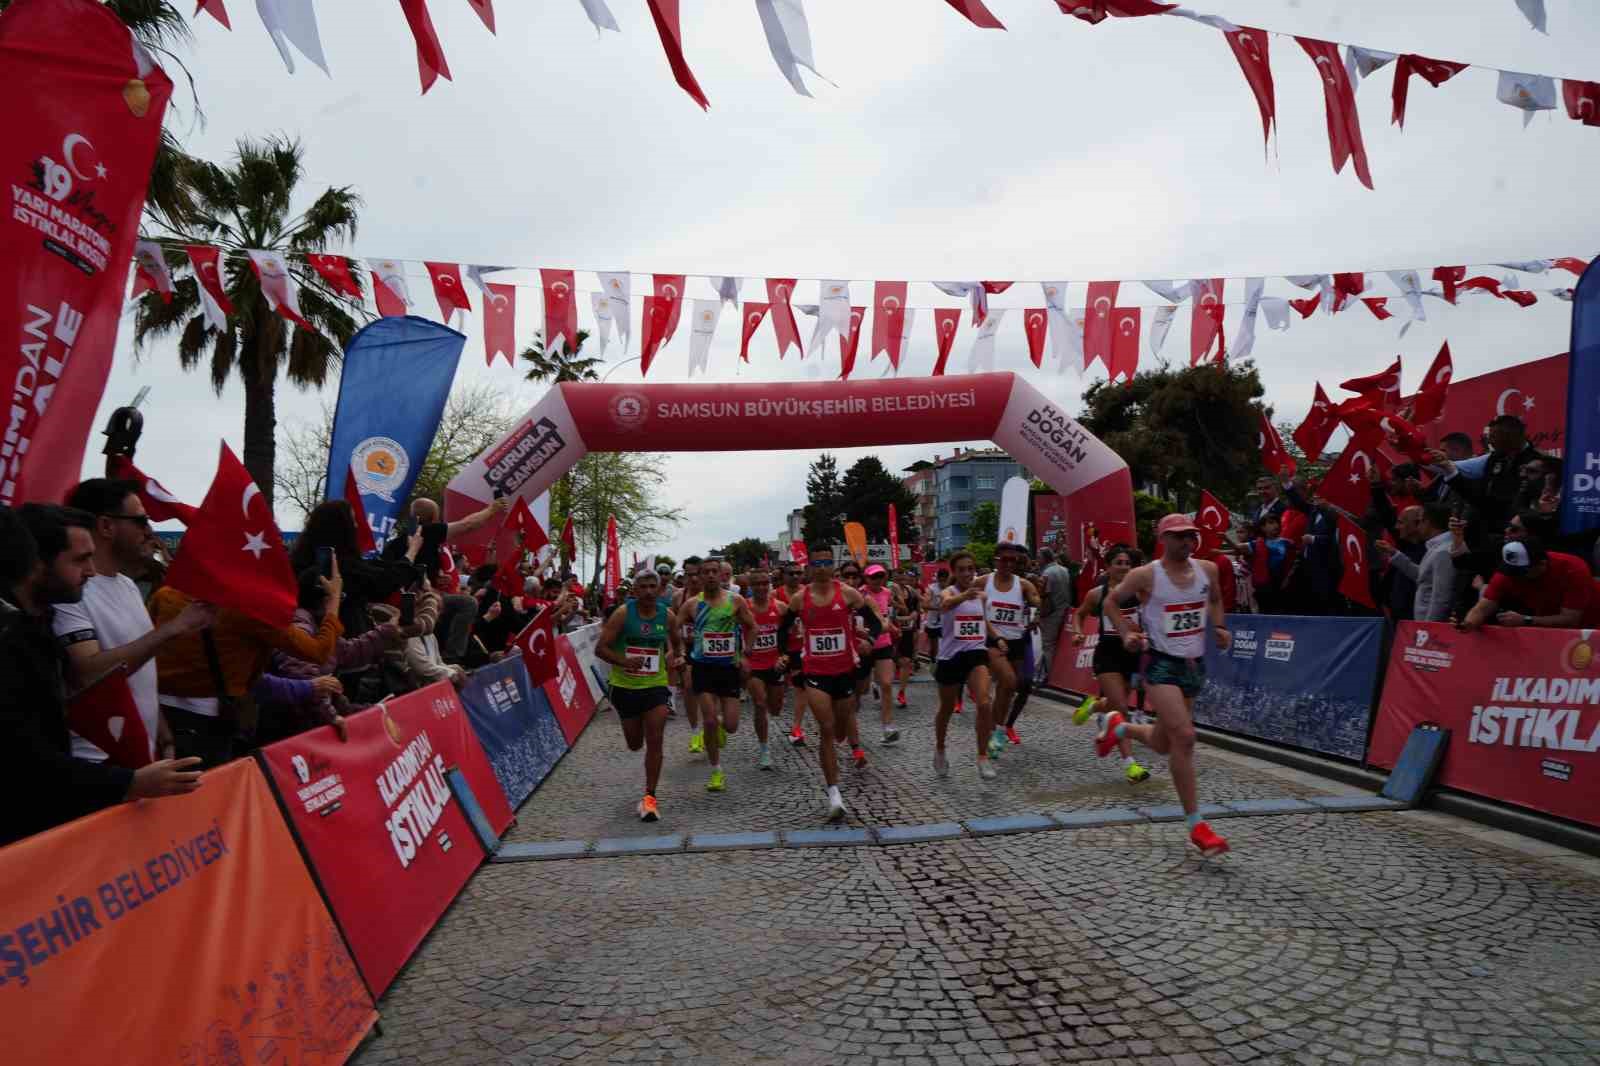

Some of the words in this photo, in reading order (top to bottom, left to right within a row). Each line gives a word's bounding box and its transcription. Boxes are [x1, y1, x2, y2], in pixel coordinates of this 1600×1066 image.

[656, 402, 740, 419] SAMSUN
[743, 395, 868, 419] BÜYÜKŞEHİR
[870, 389, 977, 412] BELEDİYESİ
[488, 424, 552, 482] GURURLA
[1027, 409, 1087, 463] DOĞAN
[504, 437, 561, 491] SAMSUN
[1172, 611, 1201, 631] 235
[708, 639, 730, 653] 358
[816, 636, 839, 651] 501
[0, 894, 102, 987] ŞEHİR
[97, 816, 231, 921] BELEDİYESİ
